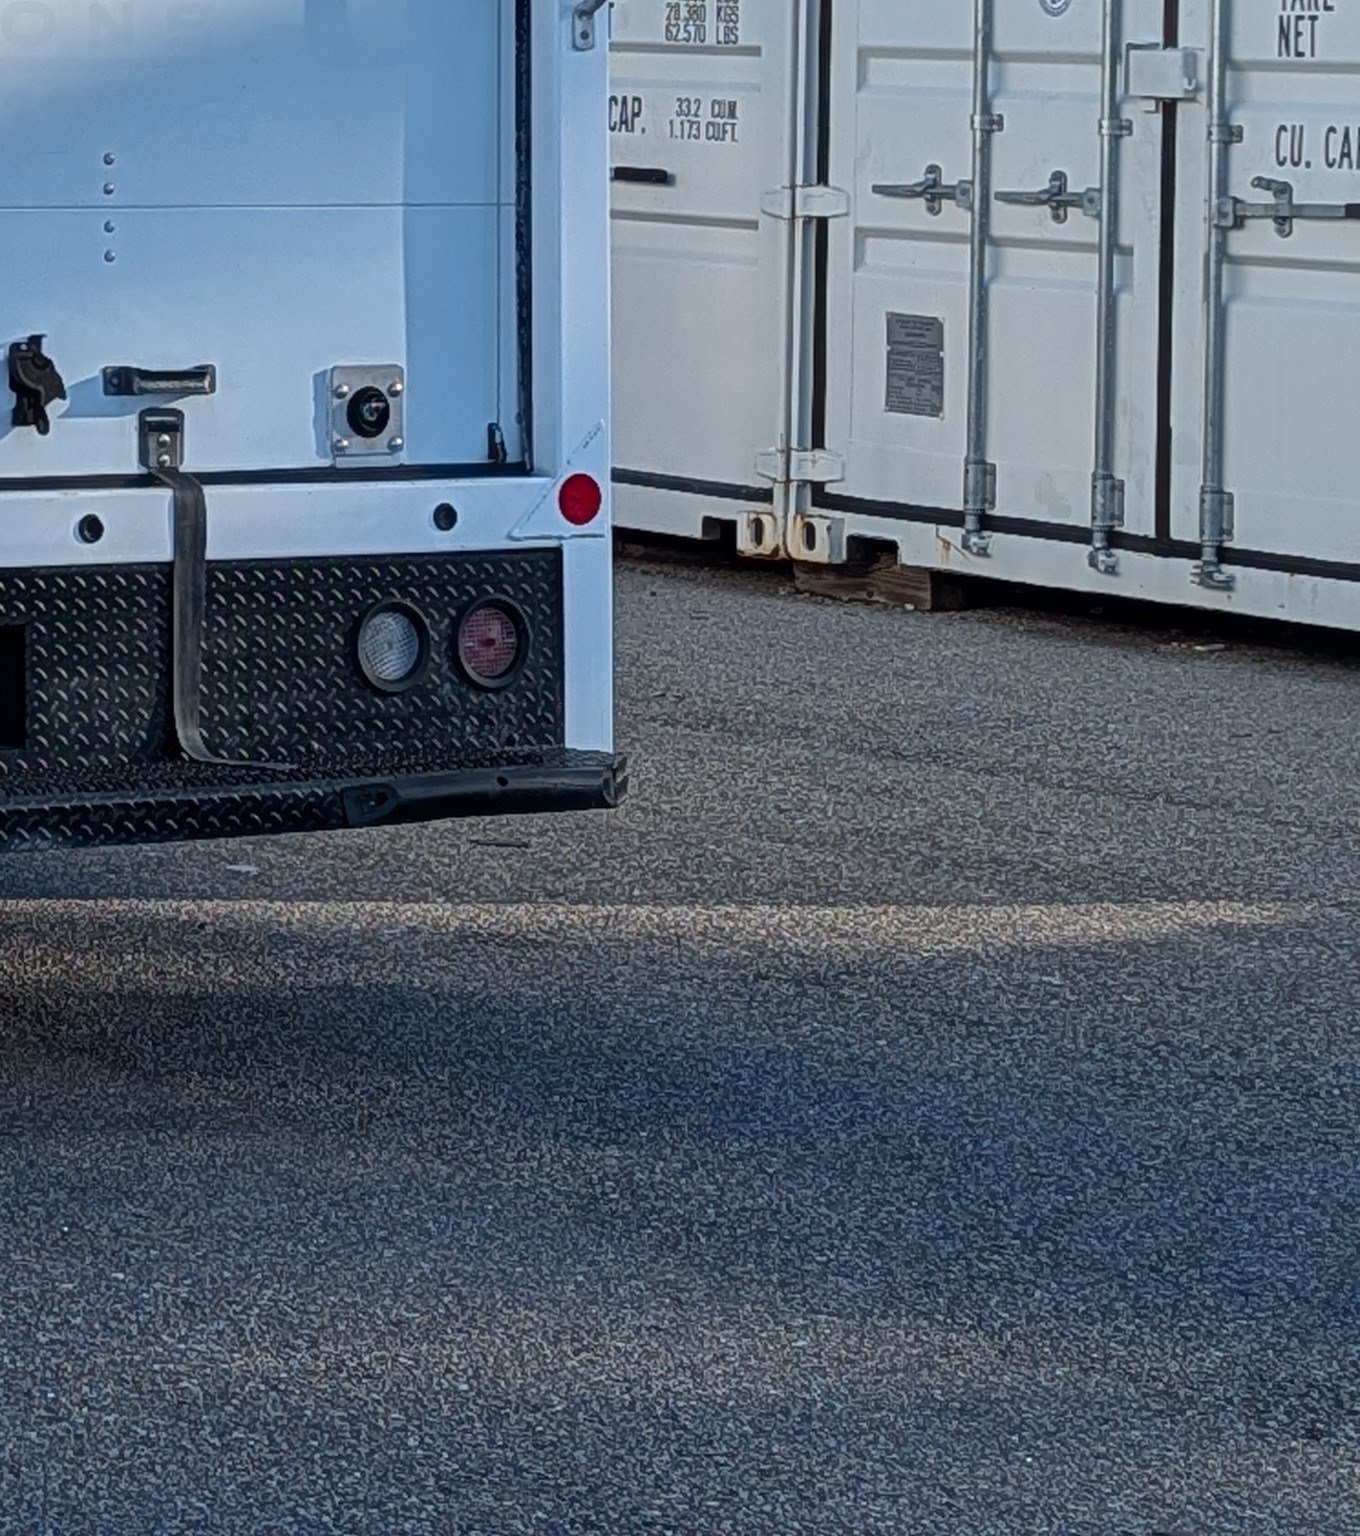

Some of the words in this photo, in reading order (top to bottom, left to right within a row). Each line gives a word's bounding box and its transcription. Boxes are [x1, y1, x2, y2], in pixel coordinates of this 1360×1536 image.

[716, 5, 739, 24] KGS
[716, 25, 739, 44] LBS
[1278, 15, 1319, 58] NET
[608, 95, 646, 135] CAP.
[669, 119, 701, 140] 1.173
[1275, 125, 1311, 169] CU.
[1325, 125, 1360, 169] CA
